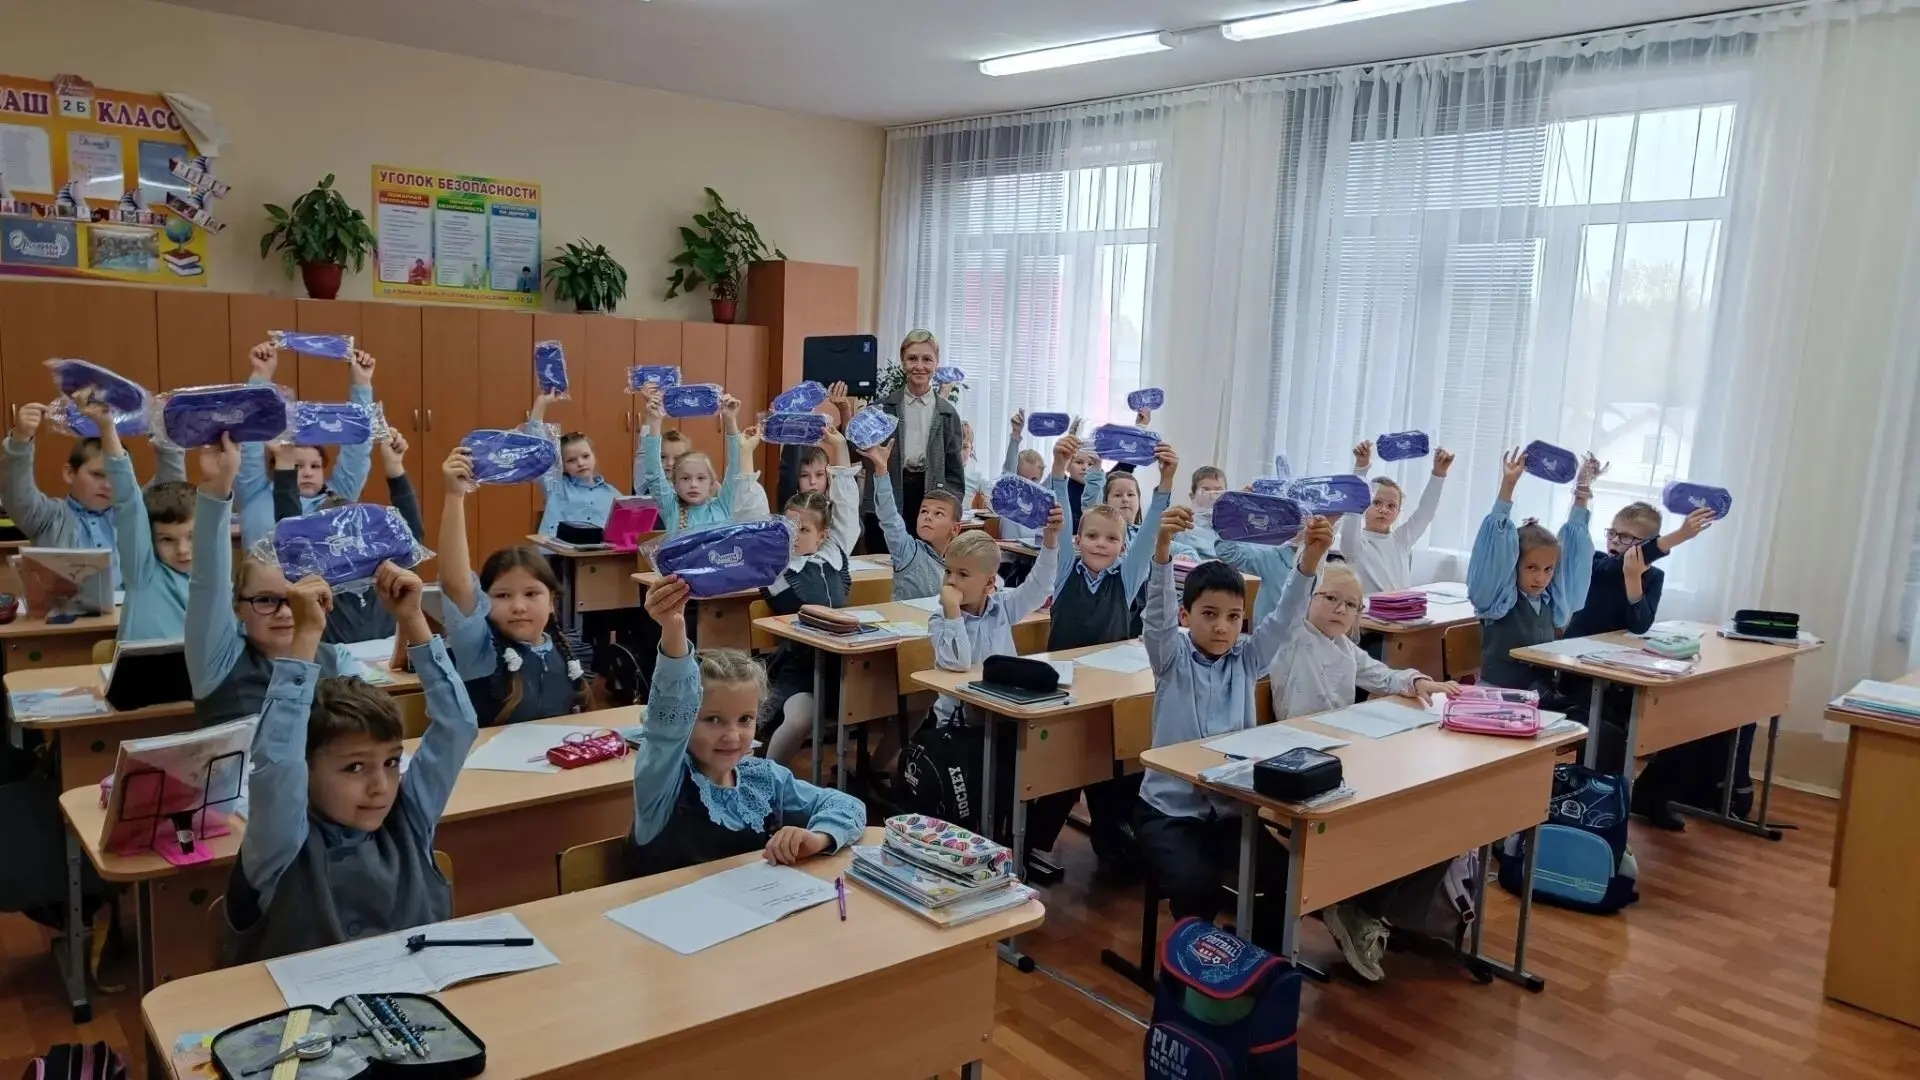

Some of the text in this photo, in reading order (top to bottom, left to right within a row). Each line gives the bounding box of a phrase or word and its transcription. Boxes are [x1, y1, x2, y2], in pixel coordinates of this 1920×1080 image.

[63, 99, 86, 113] 2 Б
[97, 102, 181, 131] КЛАСС
[380, 171, 537, 199] УГОЛОК БЕЗОПАСНОСТИ
[948, 766, 970, 819] HOCKEY
[1201, 935, 1237, 957] FOOTBALL
[1152, 1027, 1190, 1066] PLAY
